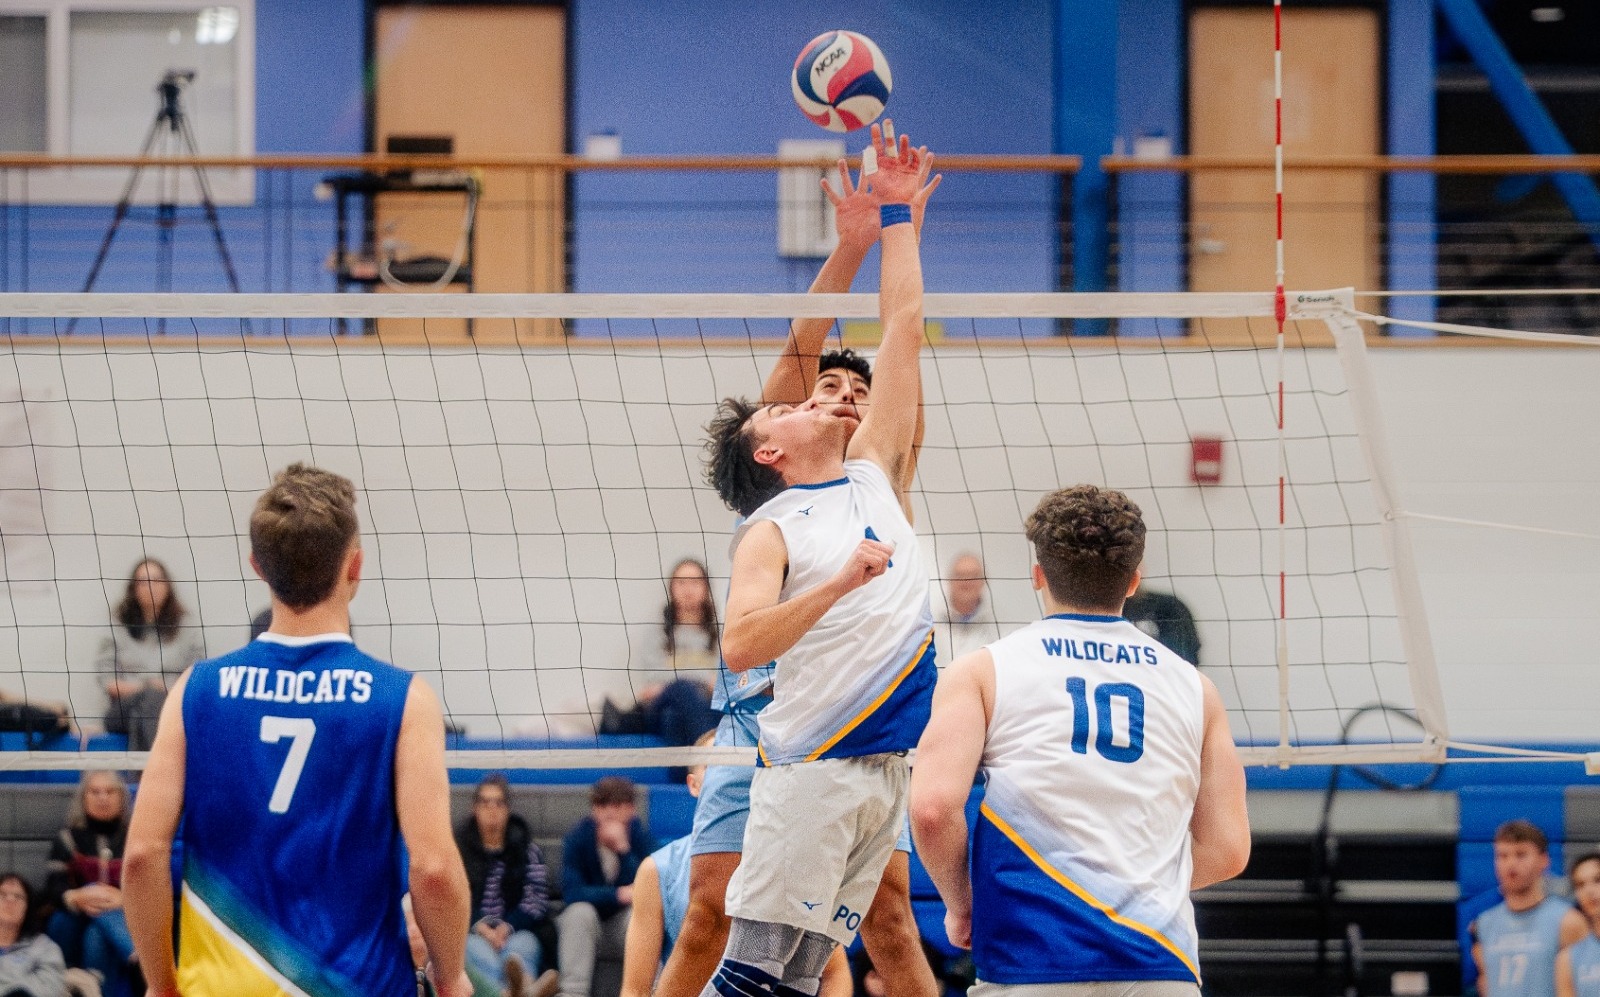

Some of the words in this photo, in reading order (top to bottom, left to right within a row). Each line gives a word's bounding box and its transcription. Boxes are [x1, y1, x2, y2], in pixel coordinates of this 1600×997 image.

[815, 47, 845, 76] NCAA
[1041, 637, 1158, 666] WILDCATS
[219, 665, 374, 704] WILDCATS
[1065, 676, 1145, 763] 10
[259, 715, 317, 814] 7
